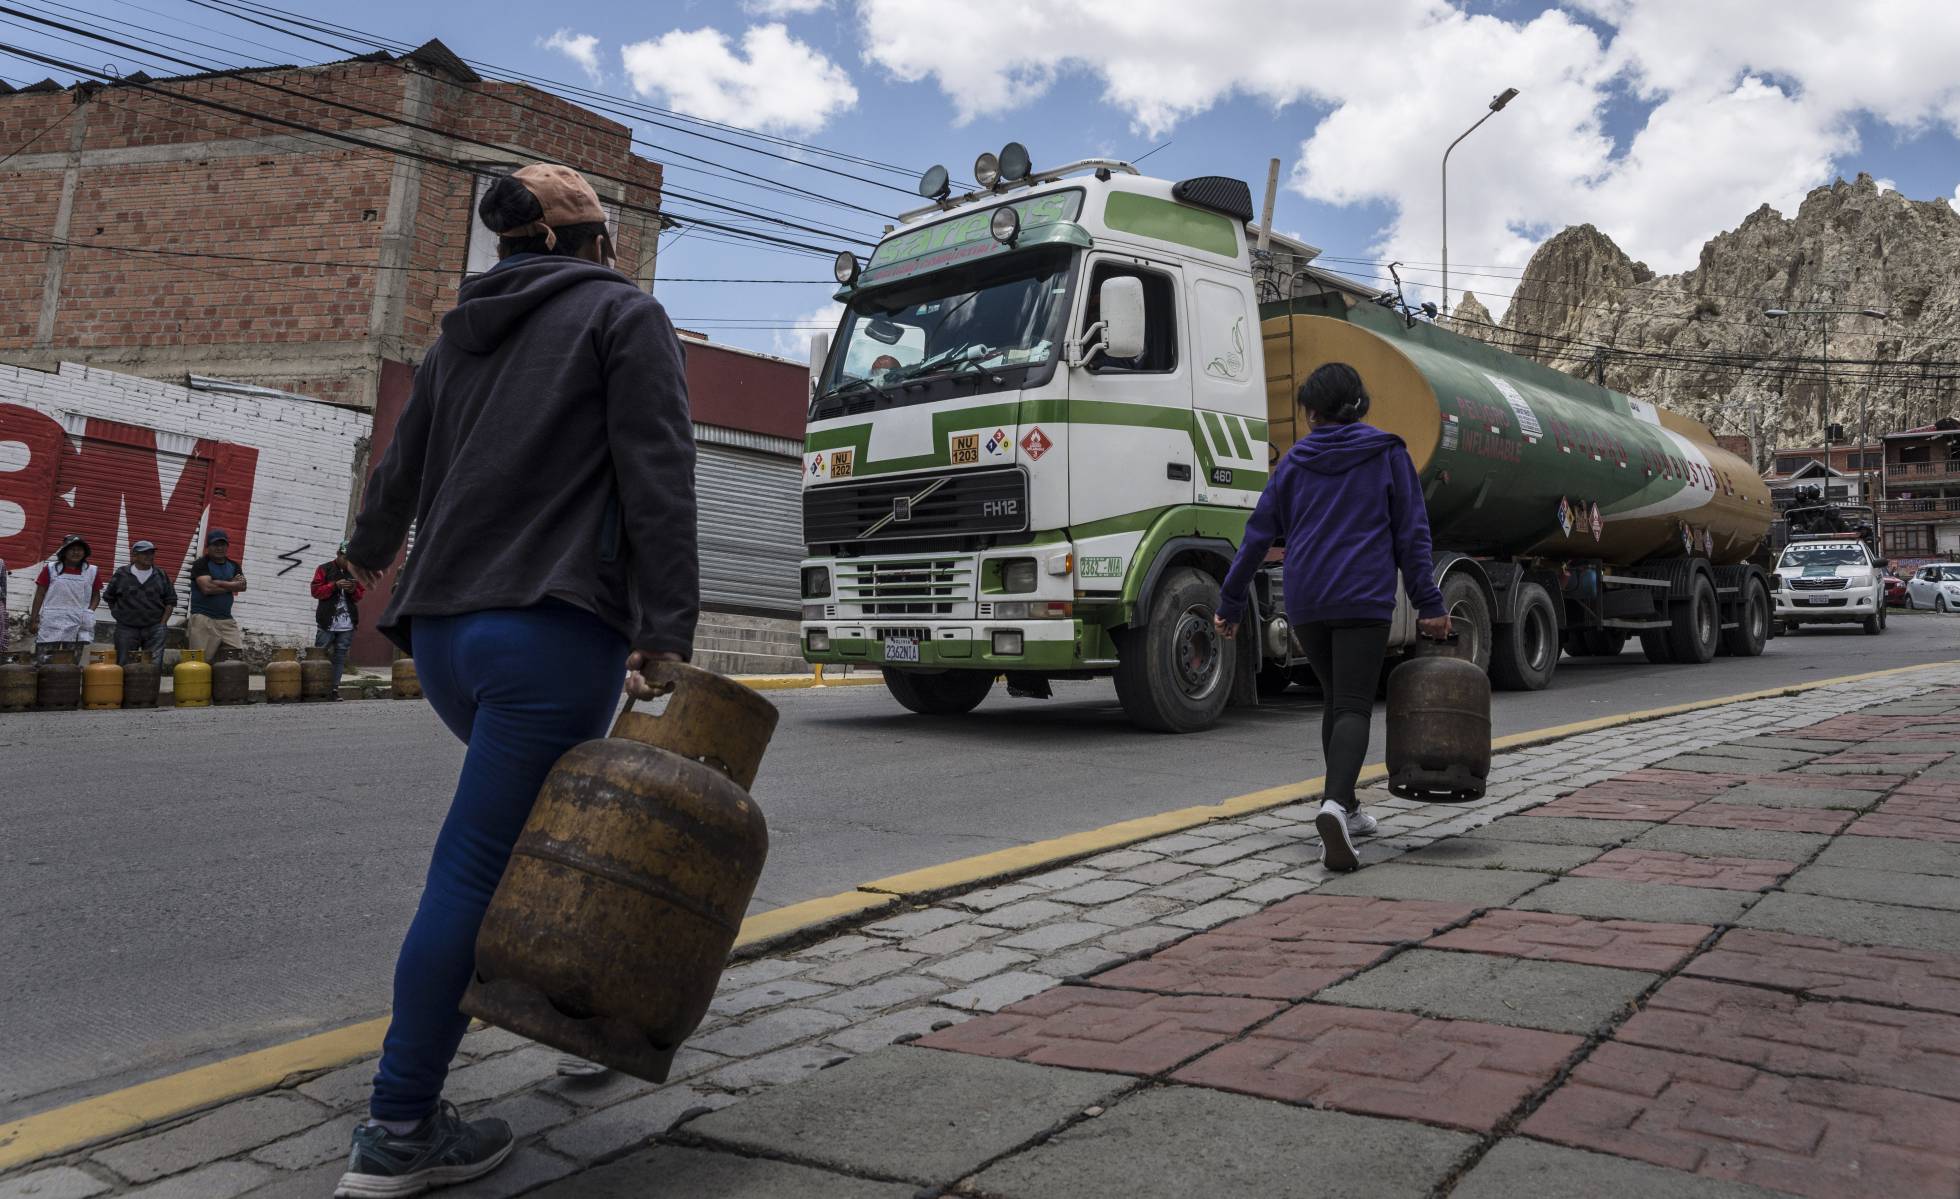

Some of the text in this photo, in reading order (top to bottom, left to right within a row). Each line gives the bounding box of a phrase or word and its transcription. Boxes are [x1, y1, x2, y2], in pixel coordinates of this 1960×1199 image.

[957, 437, 973, 449] NU
[1461, 427, 1522, 464] INFLAMABLE
[835, 453, 848, 464] NU
[953, 450, 977, 463] 1203
[832, 464, 851, 476] 1202
[1213, 468, 1232, 483] 460
[983, 500, 1017, 517] FH12
[1081, 559, 1099, 576] 2362
